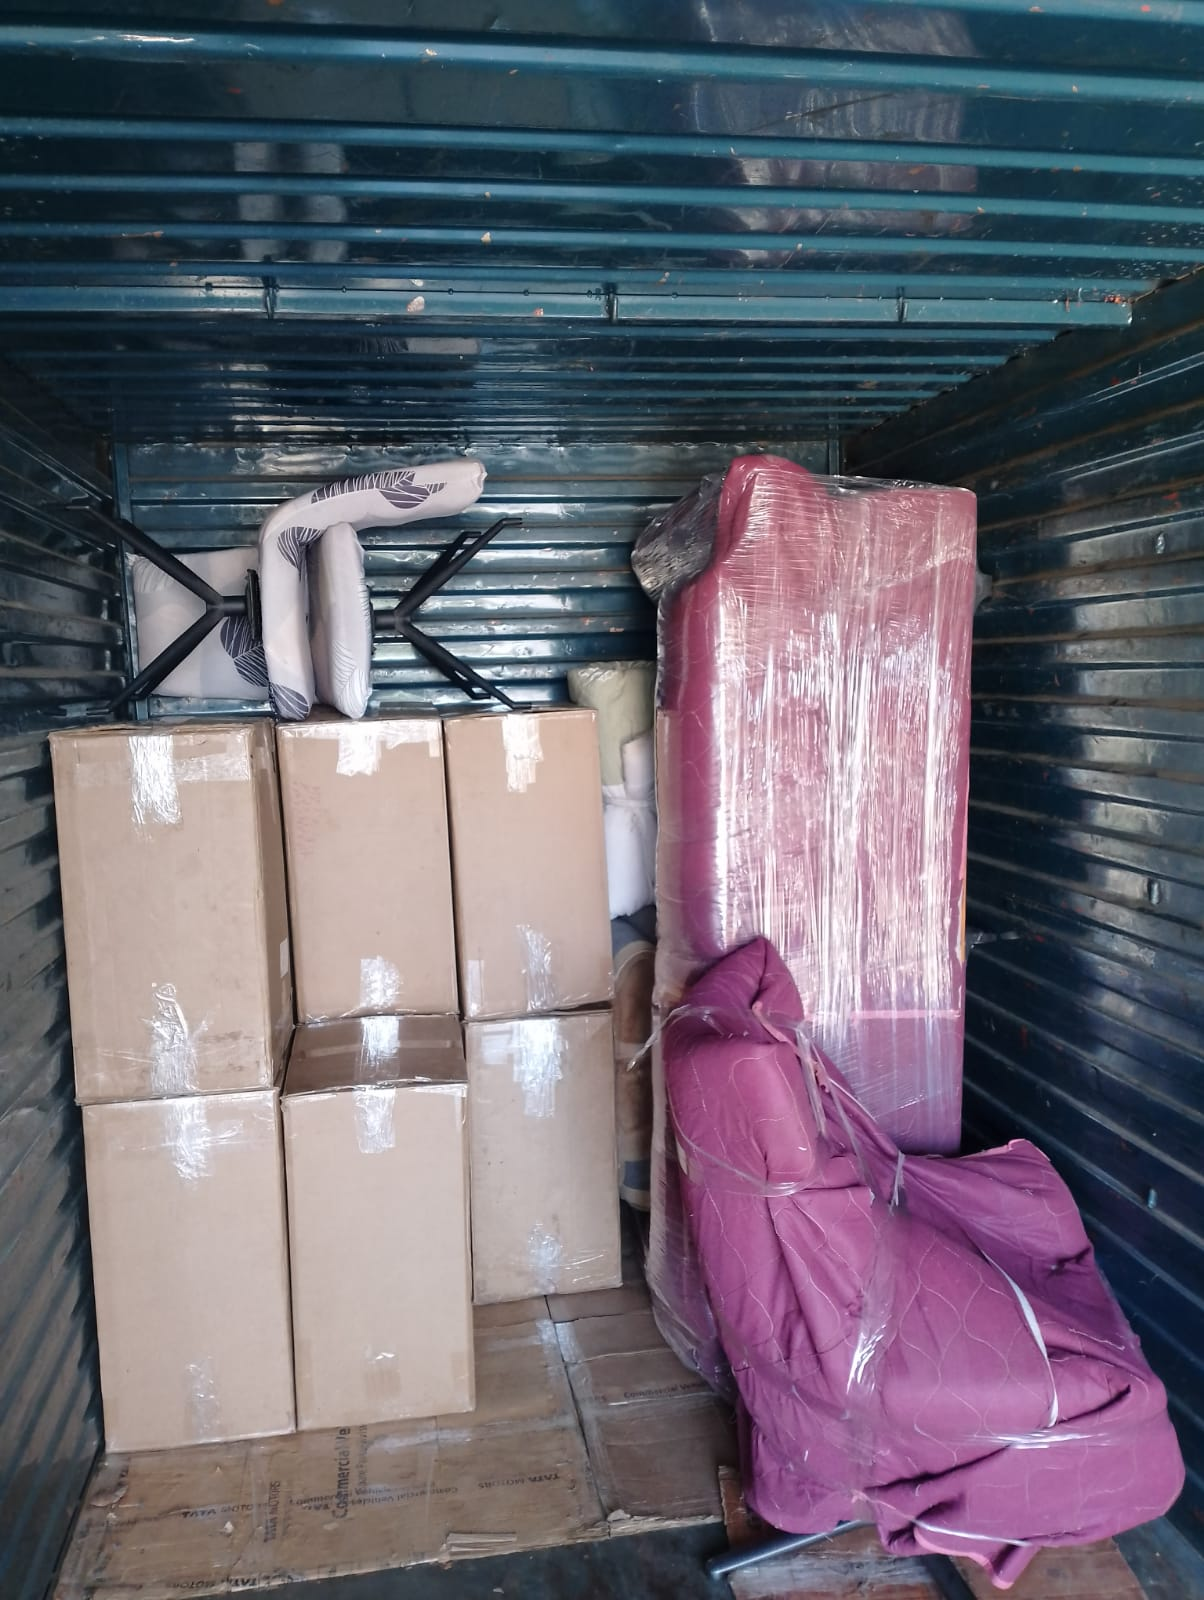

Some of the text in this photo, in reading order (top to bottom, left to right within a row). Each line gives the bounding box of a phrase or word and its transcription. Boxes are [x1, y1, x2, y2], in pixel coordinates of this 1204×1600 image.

[332, 1447, 350, 1519] Commercial
[528, 1473, 560, 1483] TATA
[269, 1480, 281, 1515] MOTORS
[182, 1509, 217, 1519] TATA
